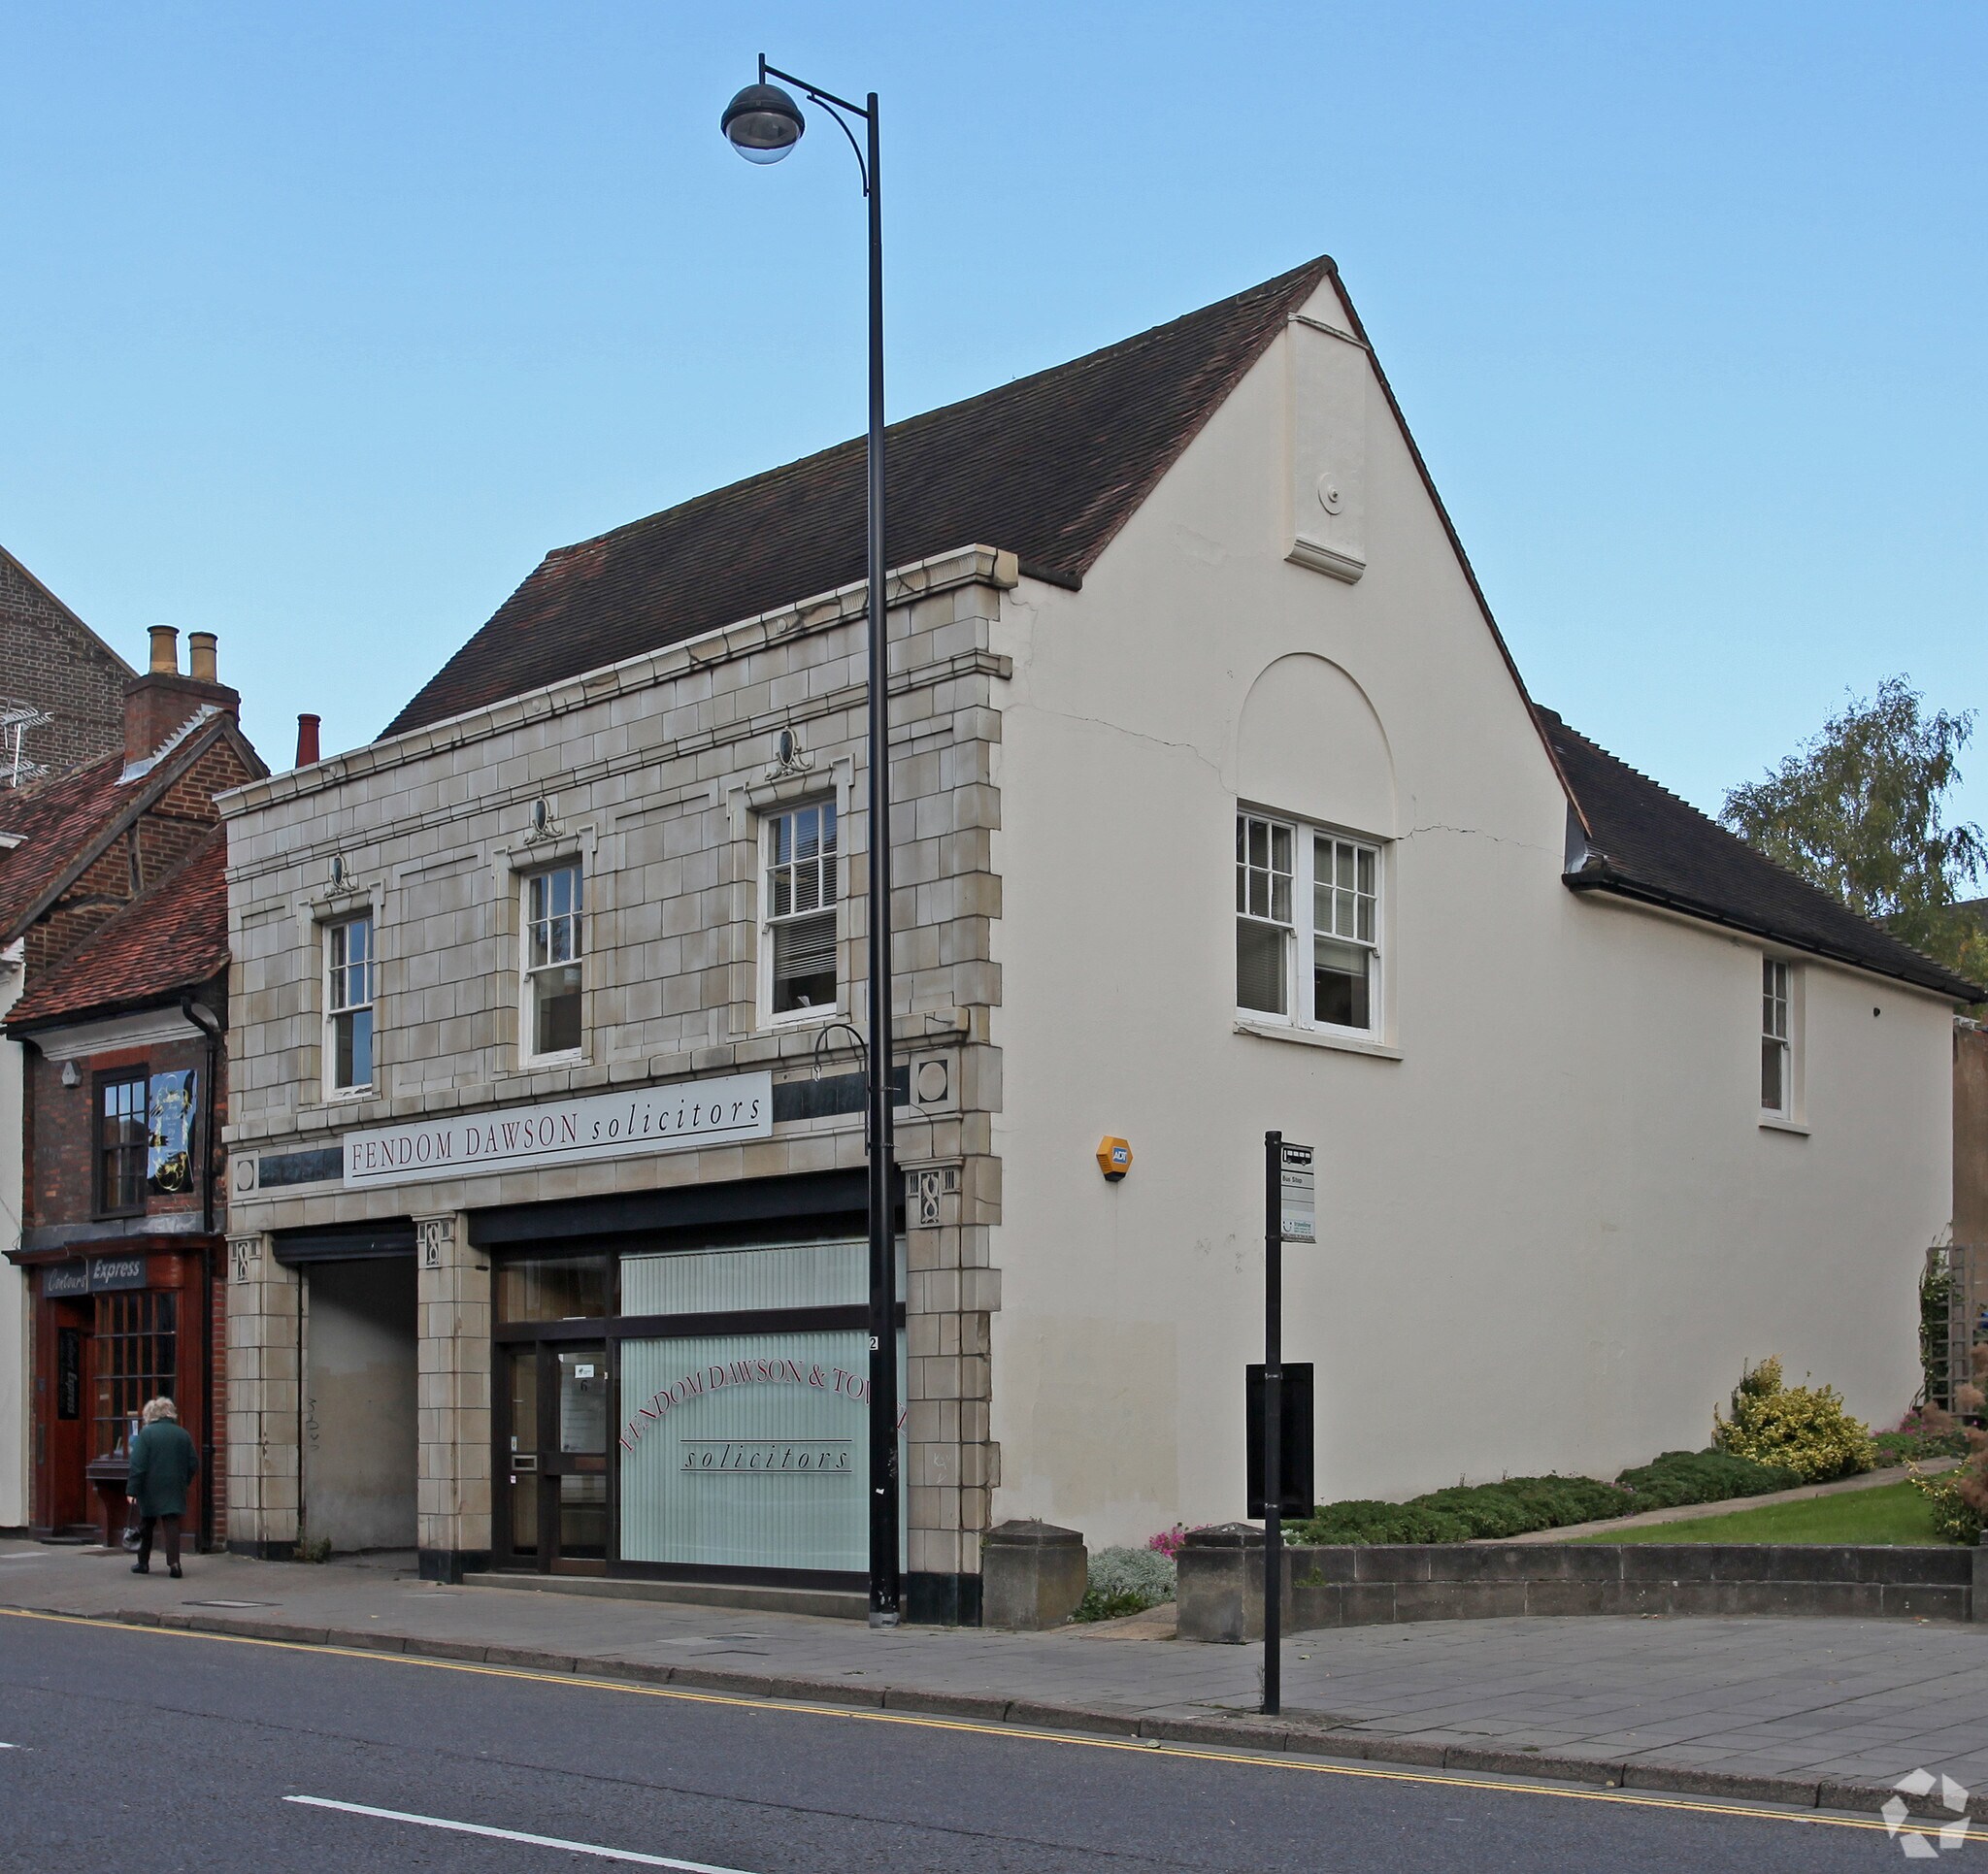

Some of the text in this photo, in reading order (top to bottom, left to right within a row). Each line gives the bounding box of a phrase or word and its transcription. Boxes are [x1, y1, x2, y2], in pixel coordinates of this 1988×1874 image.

[352, 1099, 760, 1171] FENDOM DAWSON solicitors
[48, 1259, 141, 1292] Contours Express
[620, 1371, 704, 1452] FENDOM
[708, 1358, 804, 1390] DAWSON
[808, 1364, 826, 1388] &
[684, 1443, 847, 1468] solicitors
